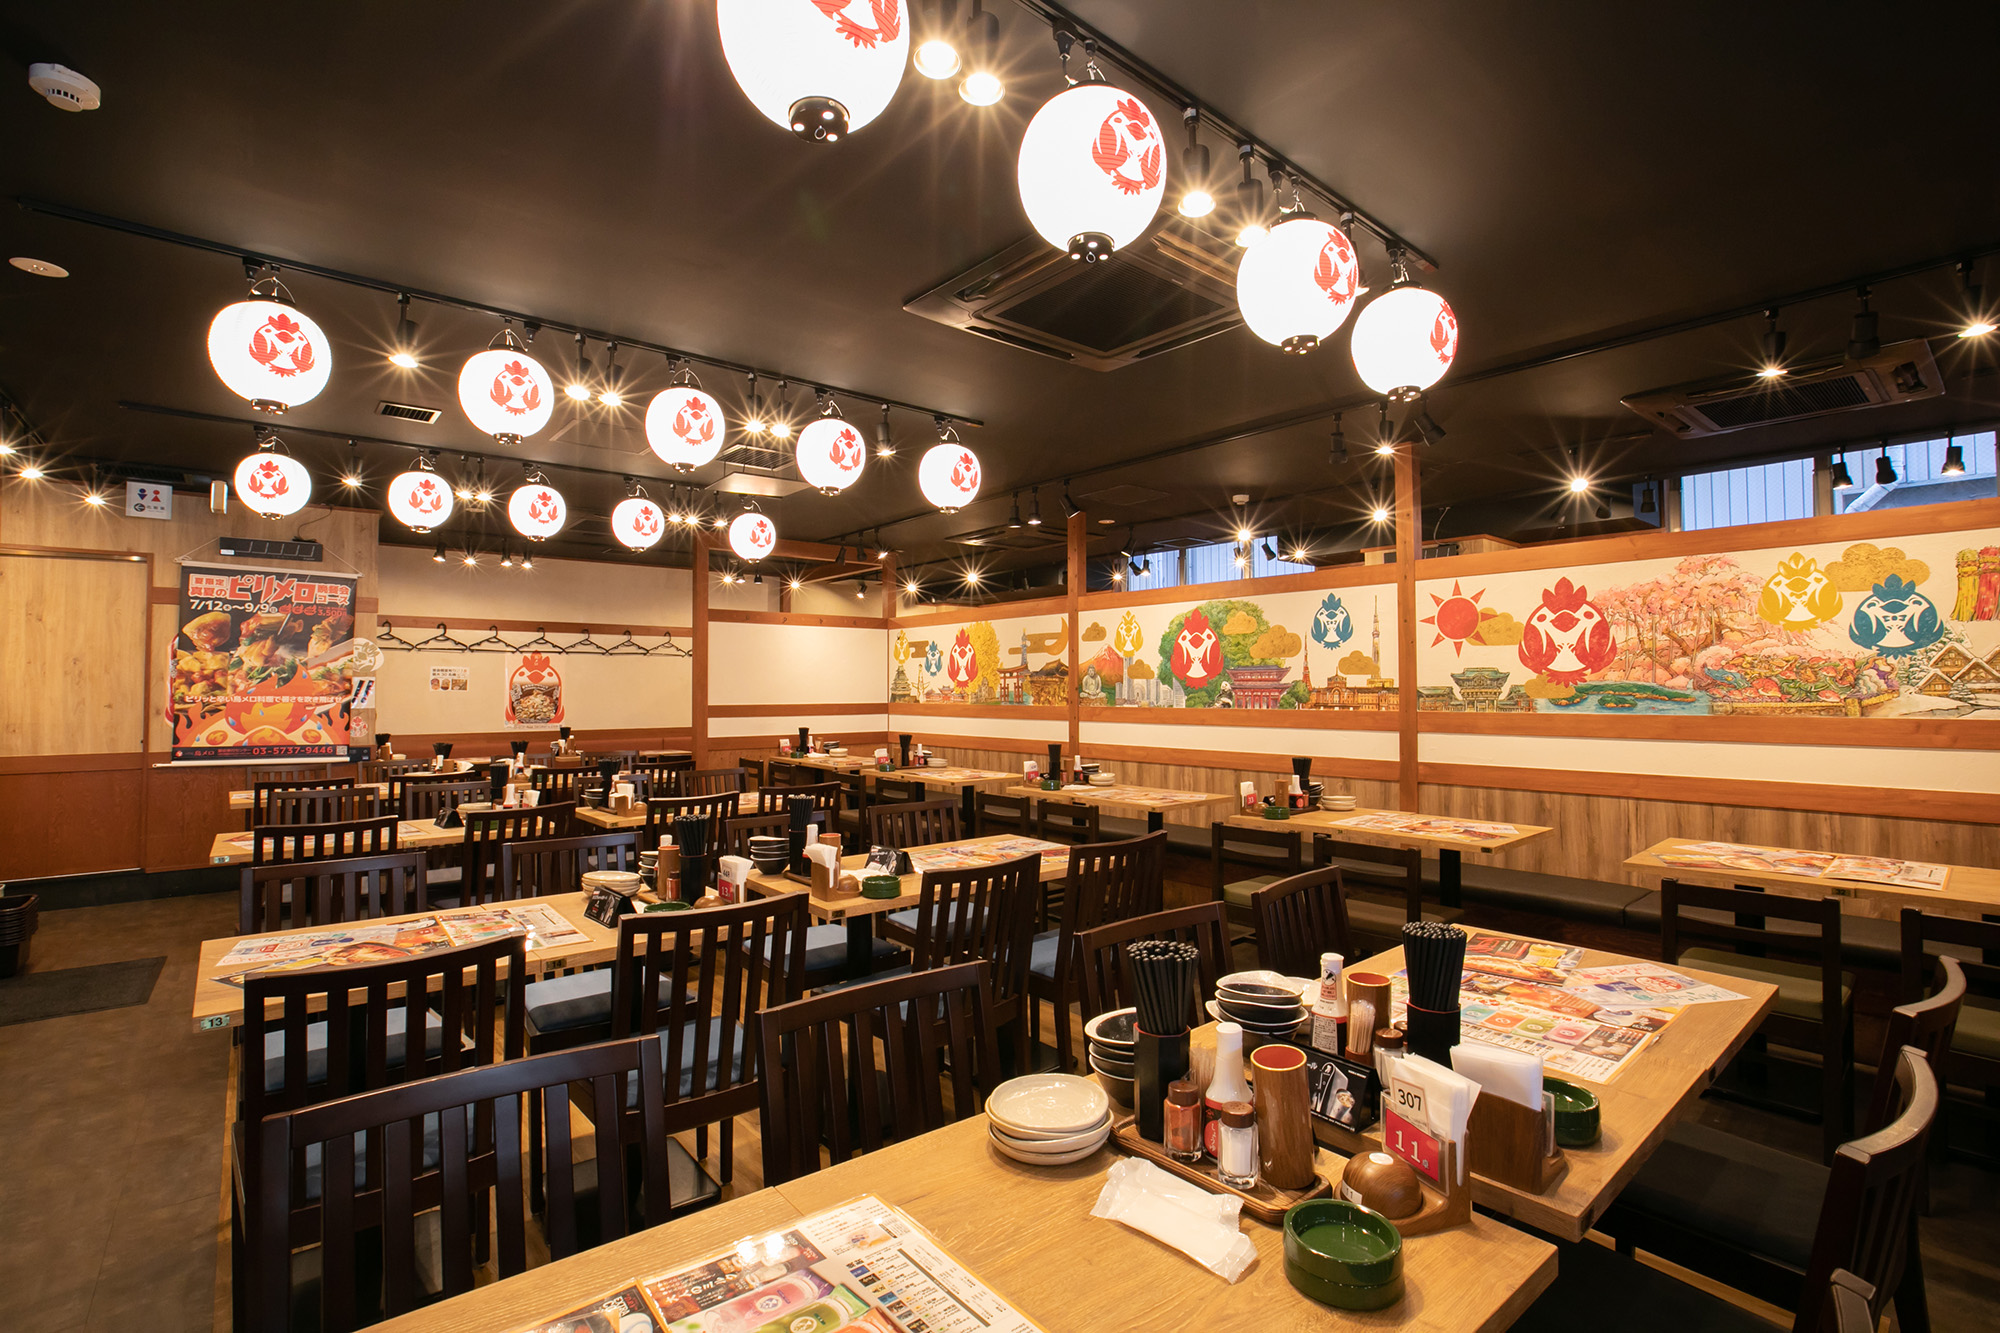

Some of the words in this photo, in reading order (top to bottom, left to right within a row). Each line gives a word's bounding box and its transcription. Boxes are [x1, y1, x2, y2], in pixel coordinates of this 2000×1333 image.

[228, 574, 317, 604] ピリメロ
[316, 594, 350, 606] コース
[252, 746, 334, 756] 03-5737-9446
[208, 1016, 223, 1027] 13
[1397, 1088, 1422, 1112] 307
